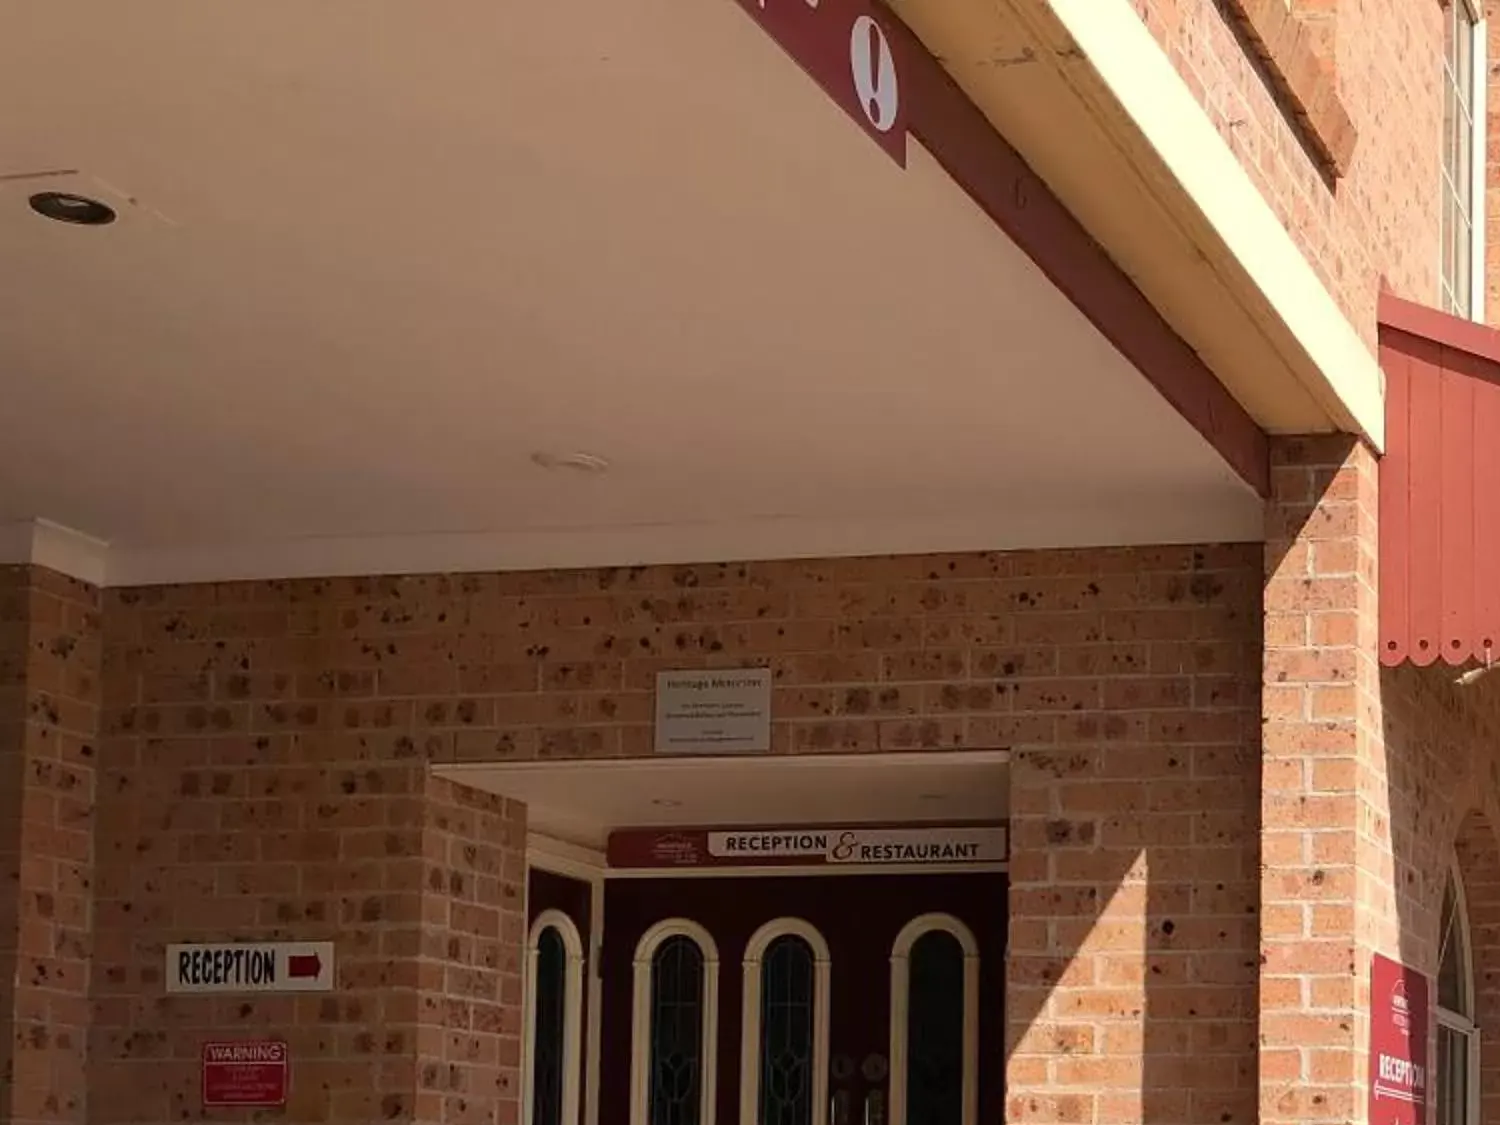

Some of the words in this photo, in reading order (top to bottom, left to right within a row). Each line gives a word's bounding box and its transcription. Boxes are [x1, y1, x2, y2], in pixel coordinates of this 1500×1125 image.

[725, 835, 828, 851] RECEPTION
[831, 831, 859, 860] &
[860, 843, 981, 860] RESTAURANT
[178, 948, 276, 985] RECEPTION
[209, 1045, 282, 1061] WARNING
[1379, 1052, 1425, 1090] RECEPTION
